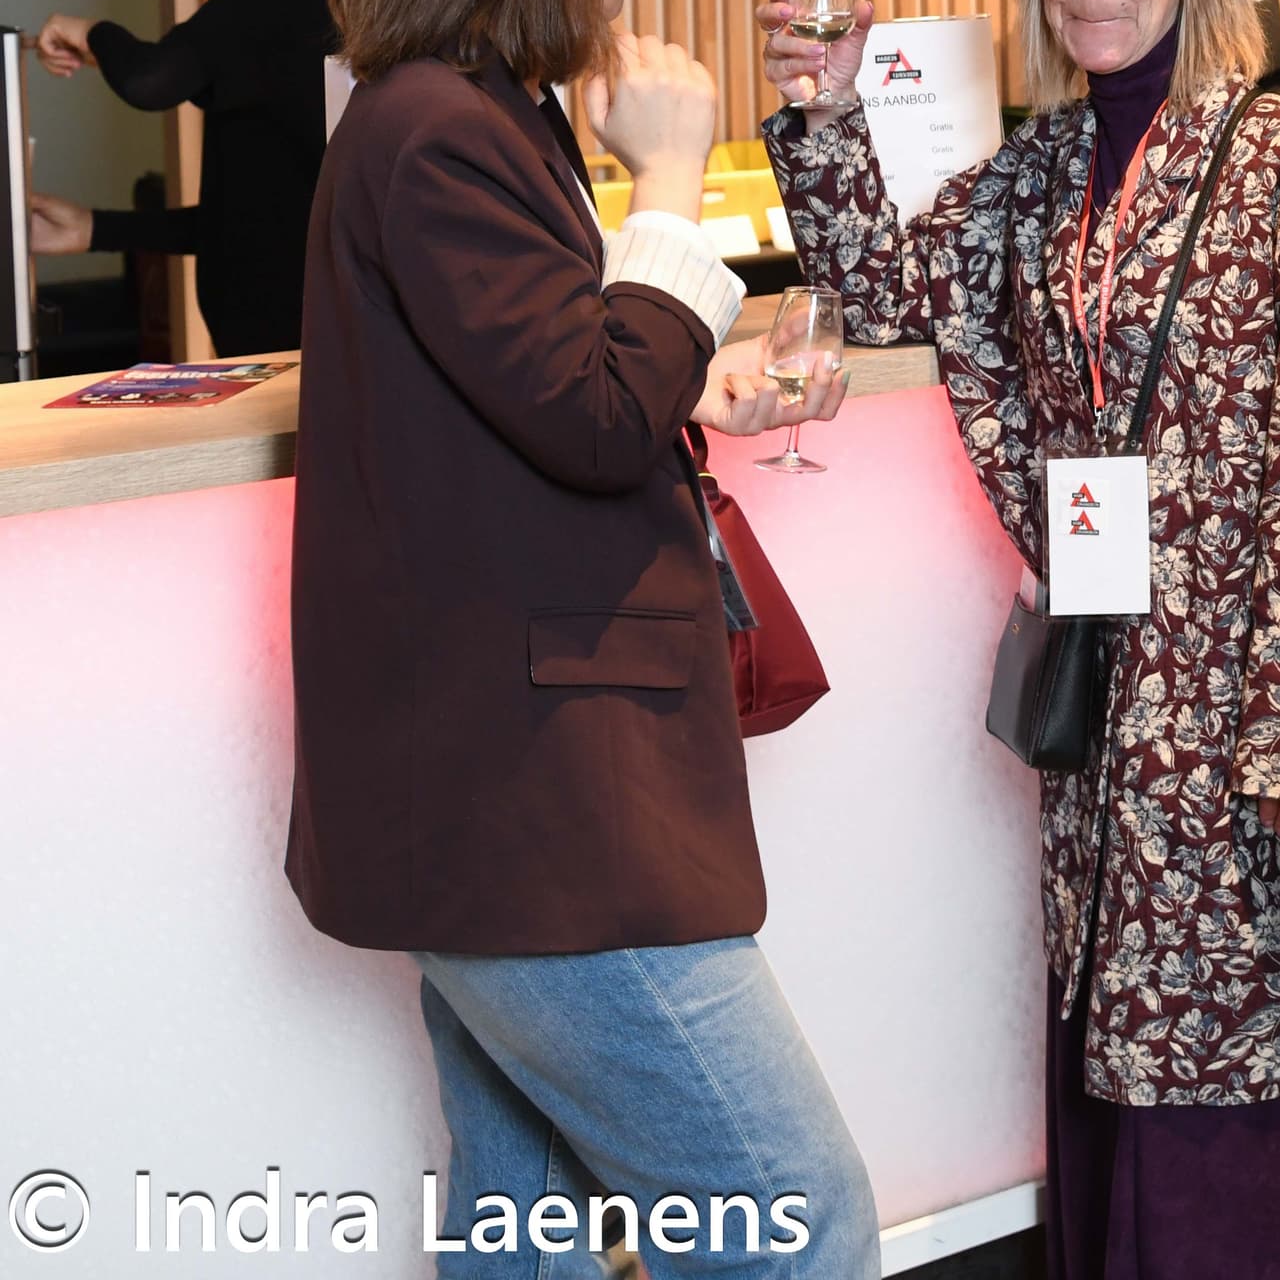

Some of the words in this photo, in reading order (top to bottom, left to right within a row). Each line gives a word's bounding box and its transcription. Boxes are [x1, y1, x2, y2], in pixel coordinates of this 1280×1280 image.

[863, 96, 880, 108] NS
[883, 93, 937, 107] AANBOD
[929, 123, 954, 132] Gratis
[931, 145, 954, 154] Gratis
